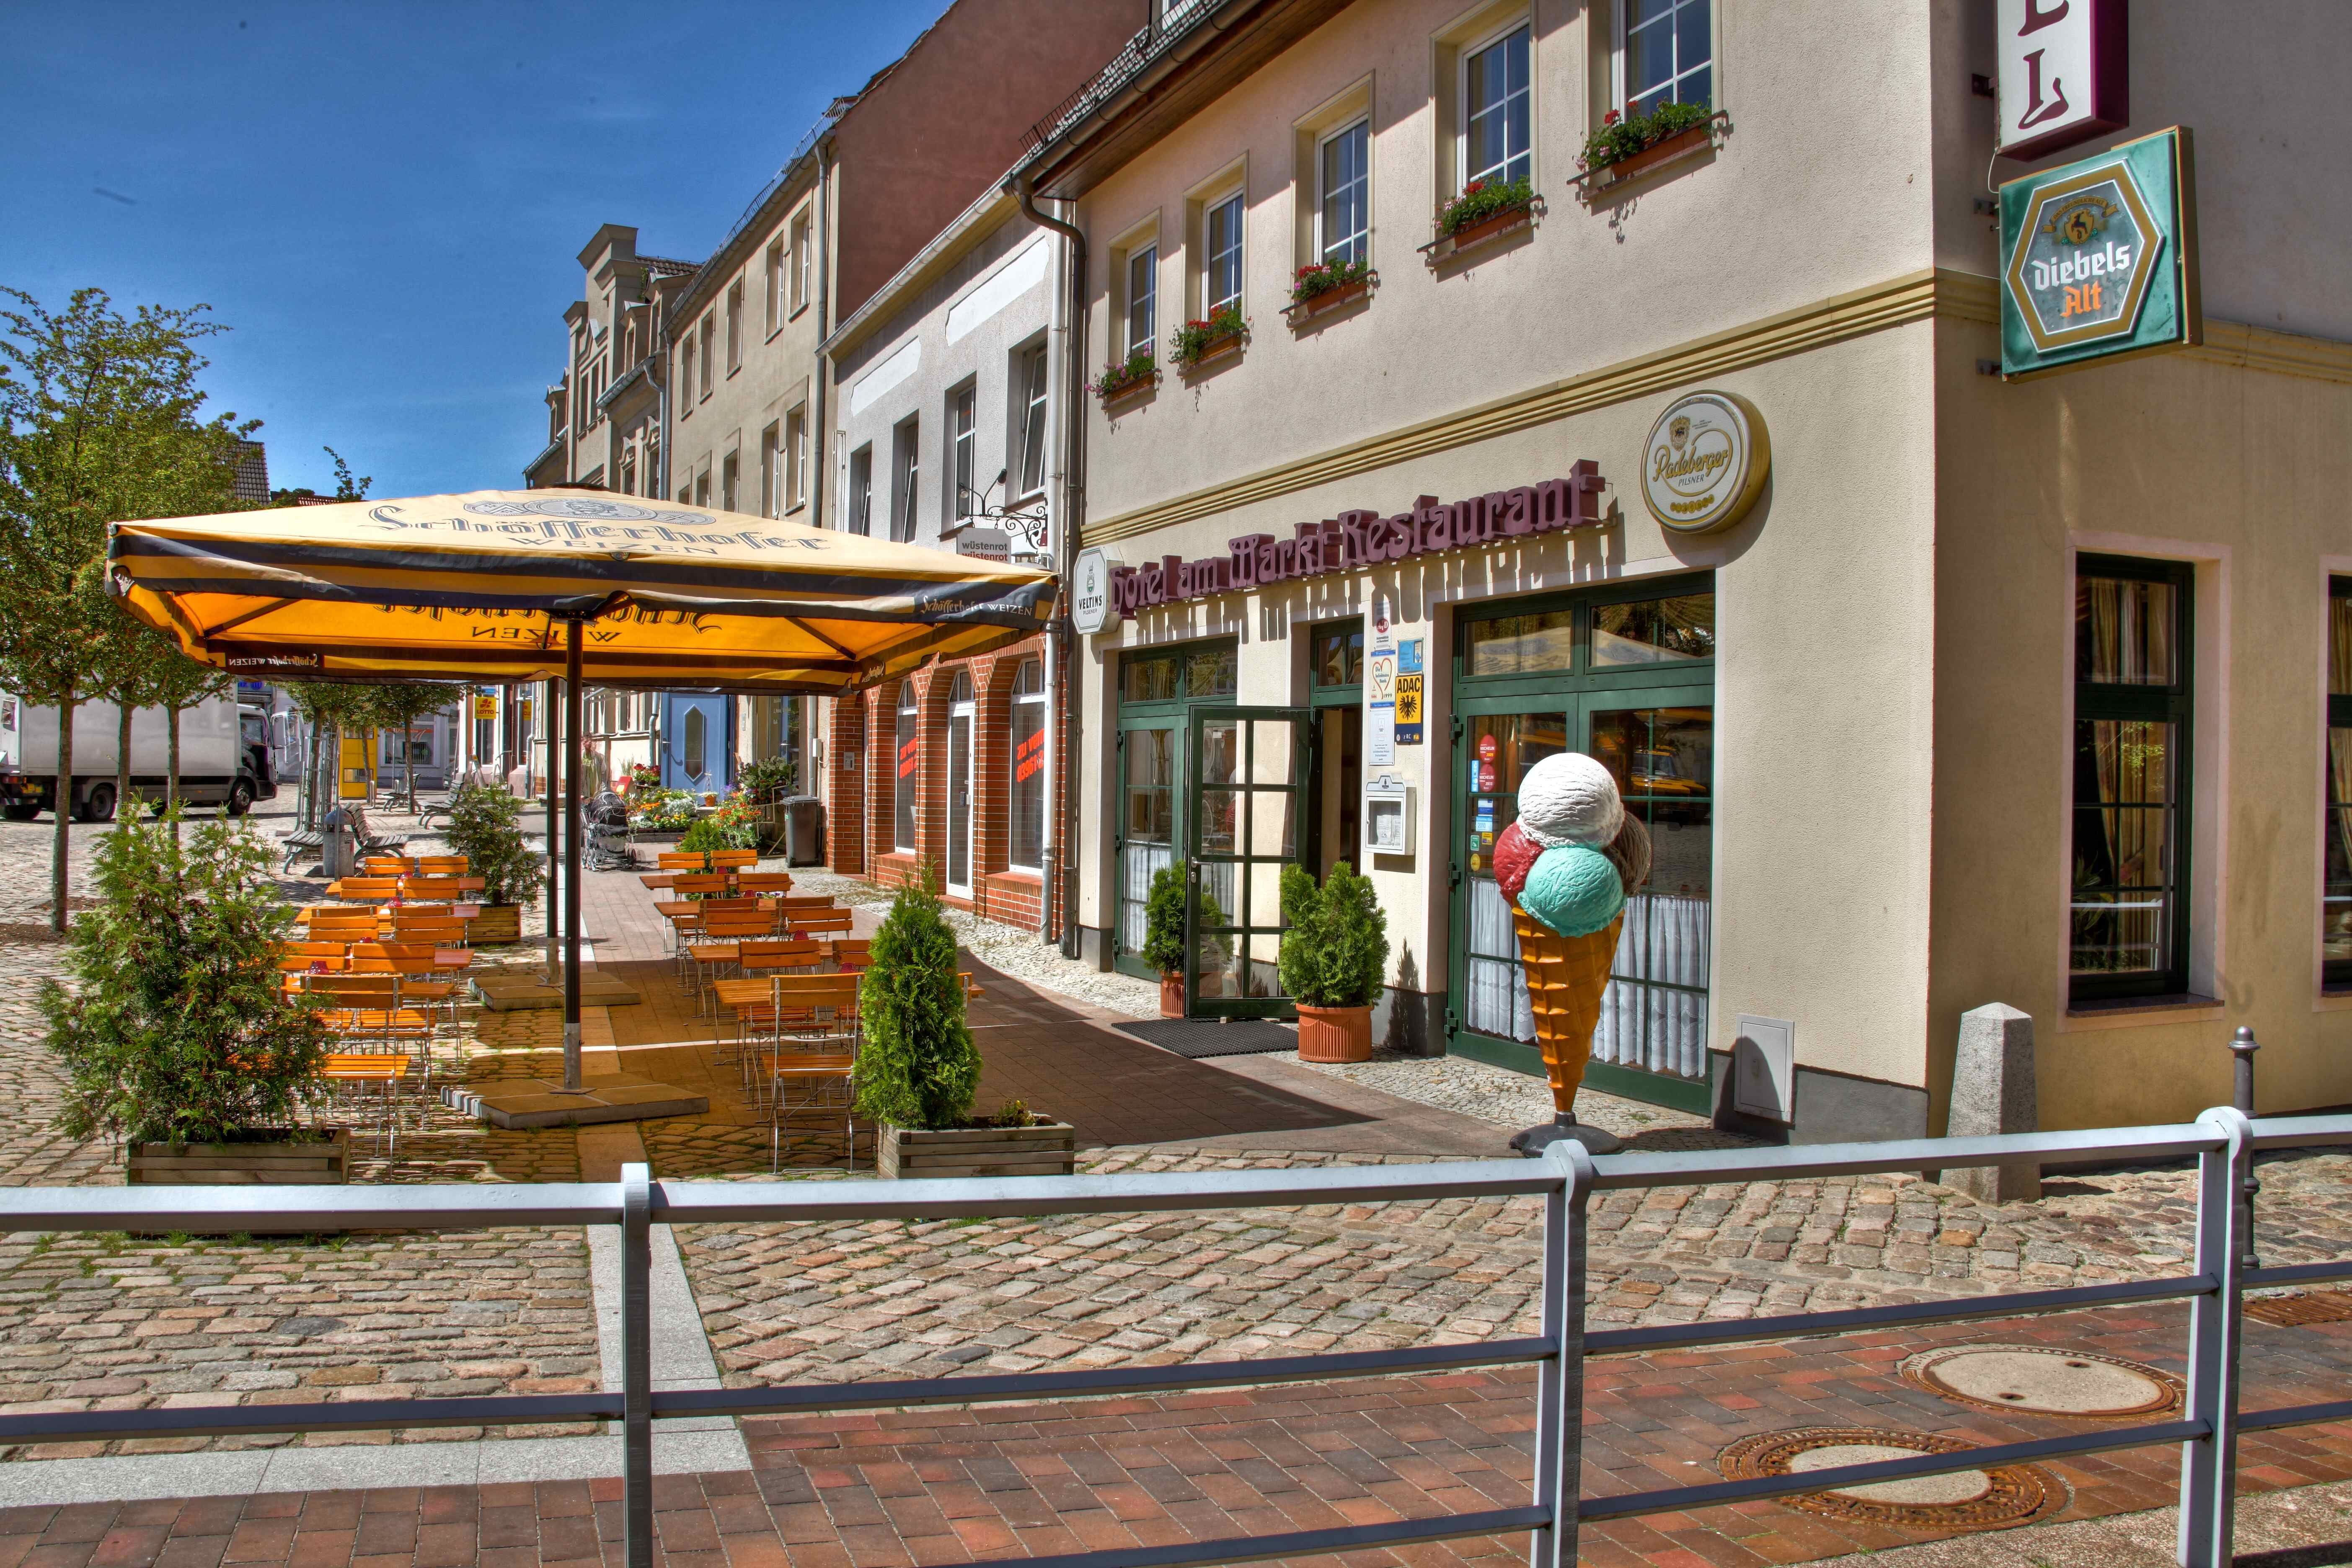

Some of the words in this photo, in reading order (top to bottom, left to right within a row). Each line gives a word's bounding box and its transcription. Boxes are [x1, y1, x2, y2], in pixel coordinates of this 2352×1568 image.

[2031, 241, 2131, 291] diebels
[2060, 280, 2102, 318] Alt
[1653, 444, 1729, 482] Radeberger
[1678, 474, 1705, 487] PILSNER
[359, 505, 831, 550] Schöfferhofer
[1177, 557, 1221, 598] am
[1228, 519, 1333, 588] Markt
[1337, 459, 1600, 568] Restaurant
[507, 537, 718, 555] WEIZEN
[962, 541, 1008, 551] wüstenrot
[920, 595, 984, 615] Schöfferhofer
[987, 603, 1033, 616] WEIZEN
[1078, 595, 1102, 610] VELTINS
[1396, 677, 1421, 694] ADAC
